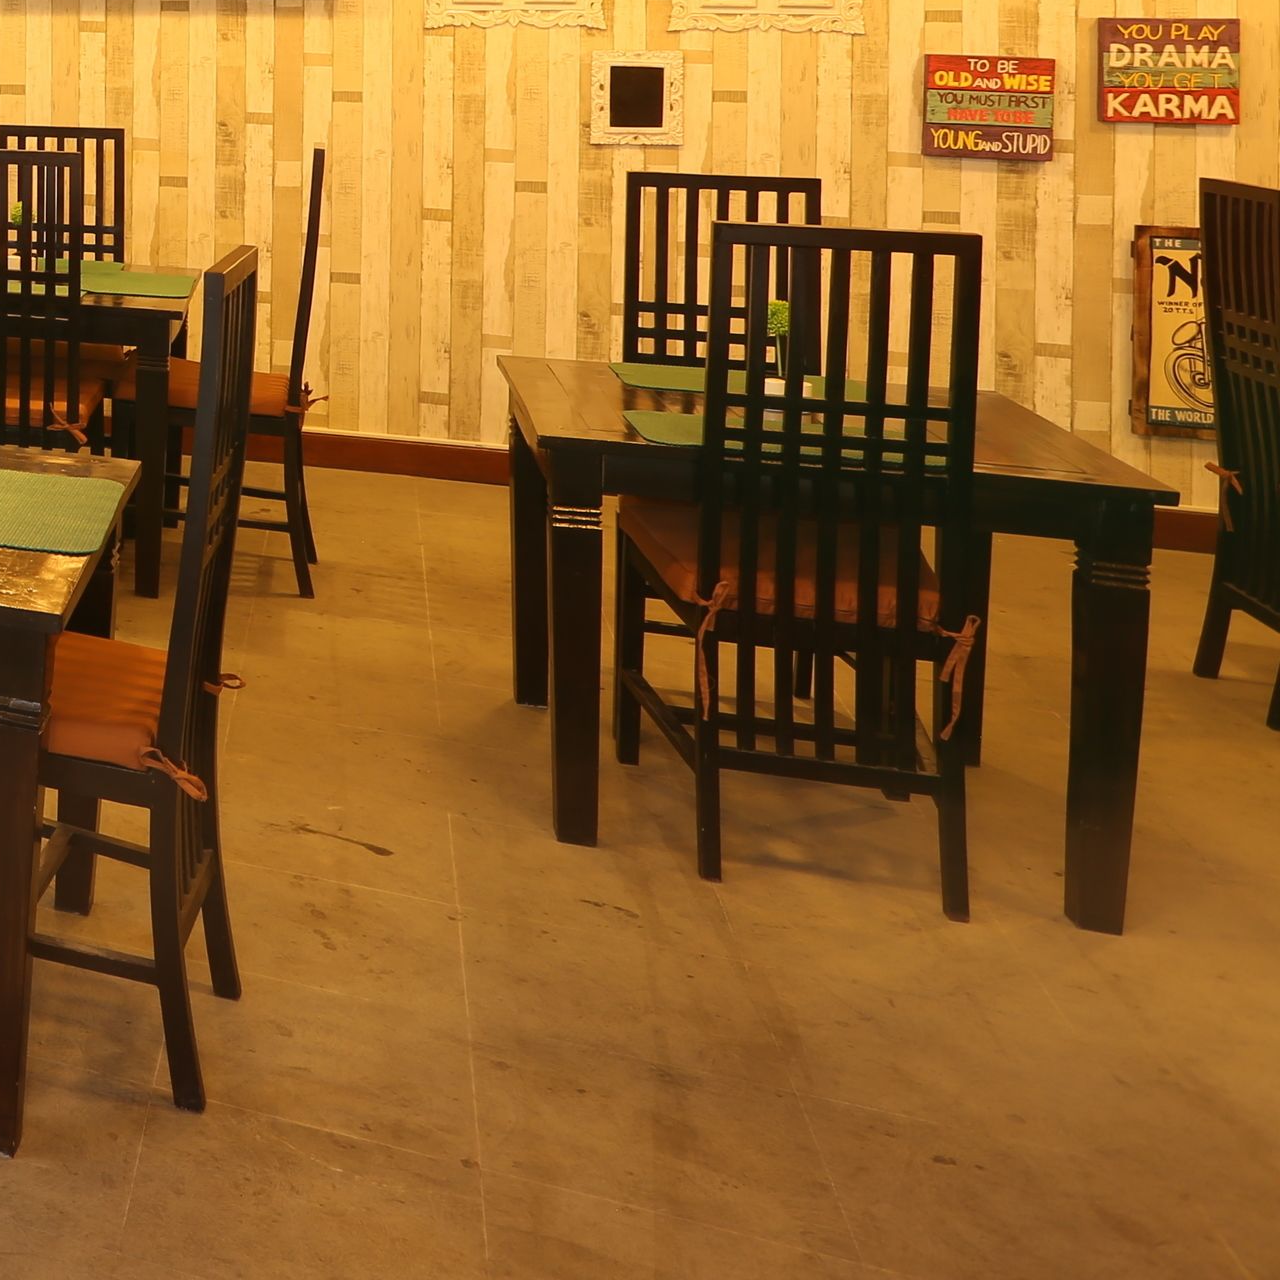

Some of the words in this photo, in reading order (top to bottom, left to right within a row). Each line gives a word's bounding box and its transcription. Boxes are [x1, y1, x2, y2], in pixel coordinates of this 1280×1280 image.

[1117, 24, 1163, 40] YOU
[1171, 23, 1226, 41] PLAY
[1109, 43, 1236, 69] DRAMA
[967, 58, 990, 72] TO
[997, 60, 1019, 73] BE
[934, 71, 973, 87] OLD
[973, 78, 1001, 89] AND
[1002, 73, 1052, 91] WISE
[1117, 72, 1163, 90] YOU
[1173, 73, 1223, 91] GET
[938, 92, 964, 104] YOU
[969, 94, 1004, 107] MUST
[1008, 95, 1050, 109] FIRST
[1106, 93, 1236, 120] KARMA
[947, 108, 989, 122] HAVE
[994, 110, 1013, 123] TO
[1014, 111, 1035, 124] BE
[930, 128, 983, 151] YOUNG
[979, 141, 1002, 152] AND
[1002, 132, 1051, 154] STUPID
[1153, 238, 1182, 248] THE
[1151, 408, 1171, 422] THE
